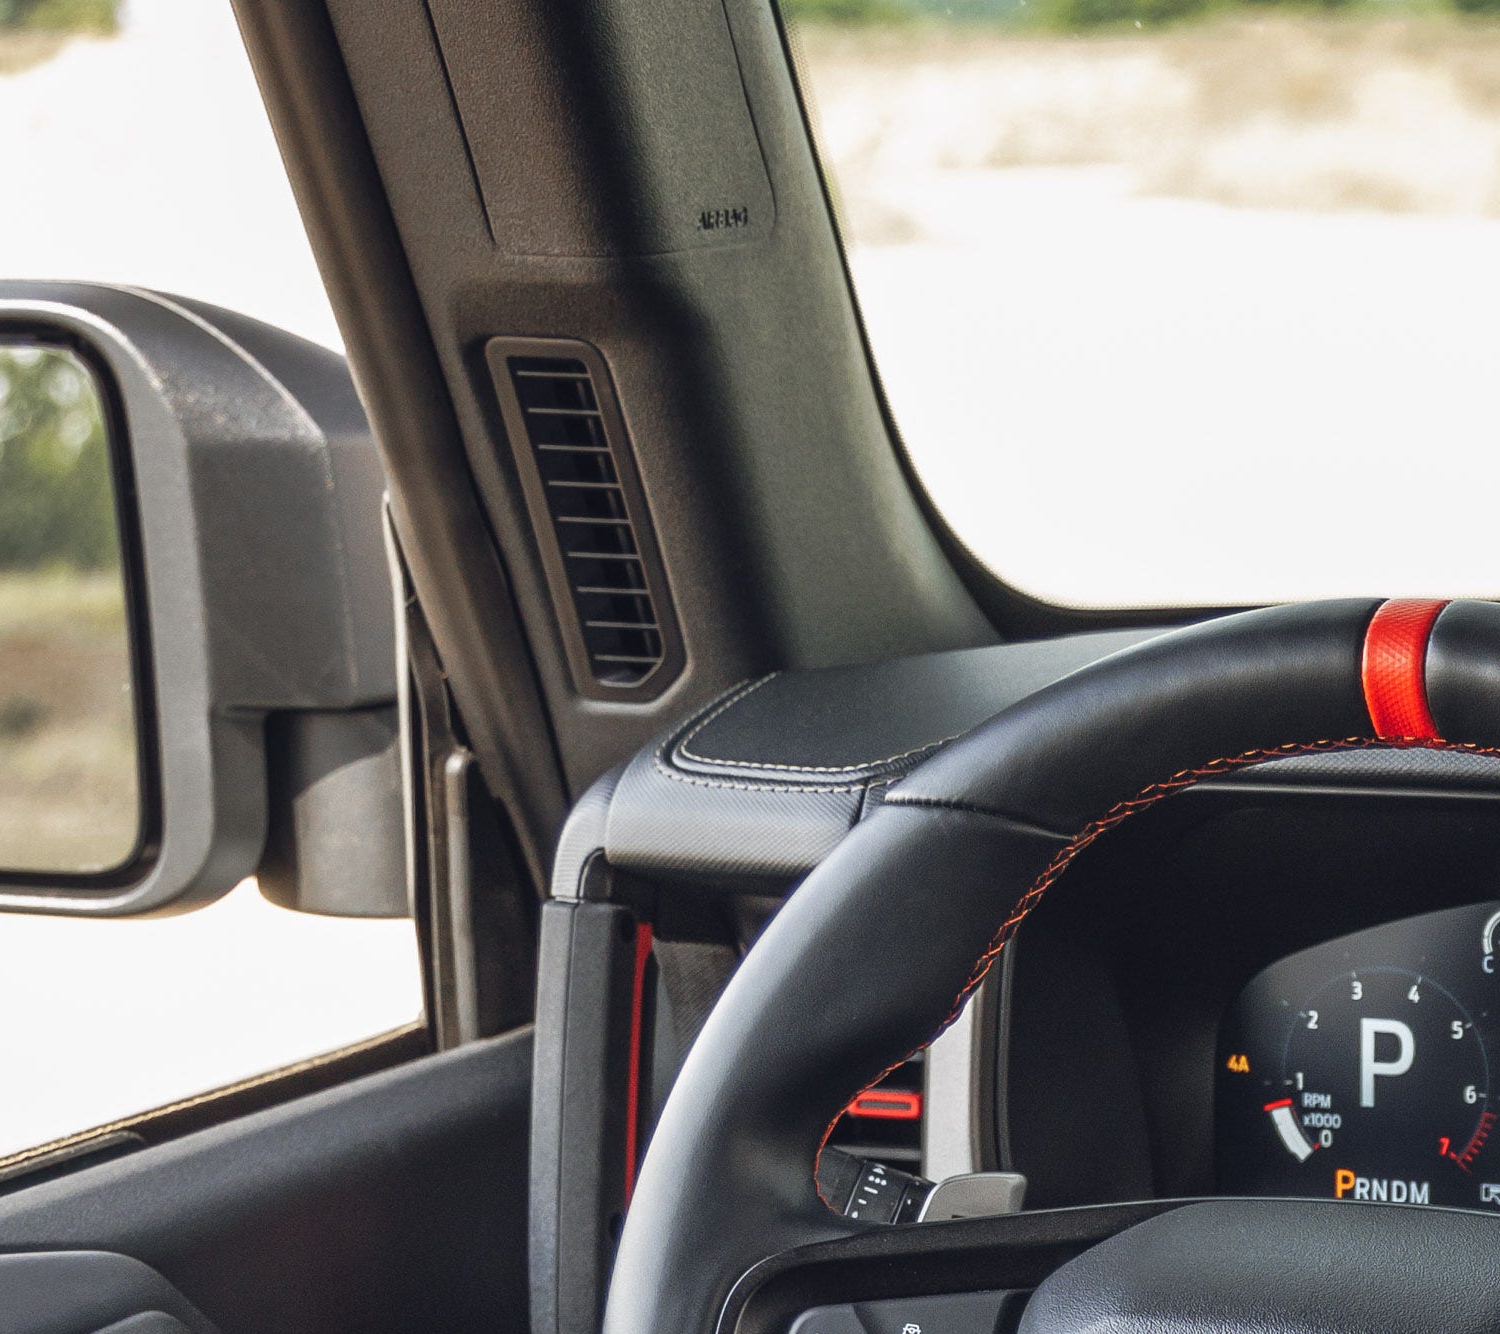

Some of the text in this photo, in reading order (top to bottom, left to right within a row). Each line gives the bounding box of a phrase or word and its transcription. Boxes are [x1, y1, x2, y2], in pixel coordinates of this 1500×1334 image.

[1482, 955, 1494, 973] C
[1351, 981, 1363, 1001] 3
[1407, 985, 1420, 1004] 4
[1306, 1010, 1319, 1030] 2
[1451, 1021, 1464, 1040] 5
[1227, 1055, 1250, 1073] 4A
[1359, 1017, 1415, 1108] P
[1295, 1072, 1304, 1090] 1
[1303, 1092, 1331, 1109] RPM
[1463, 1086, 1477, 1104] 6
[1303, 1113, 1341, 1129] x1000
[1319, 1129, 1333, 1148] 0
[1438, 1137, 1450, 1155] 7
